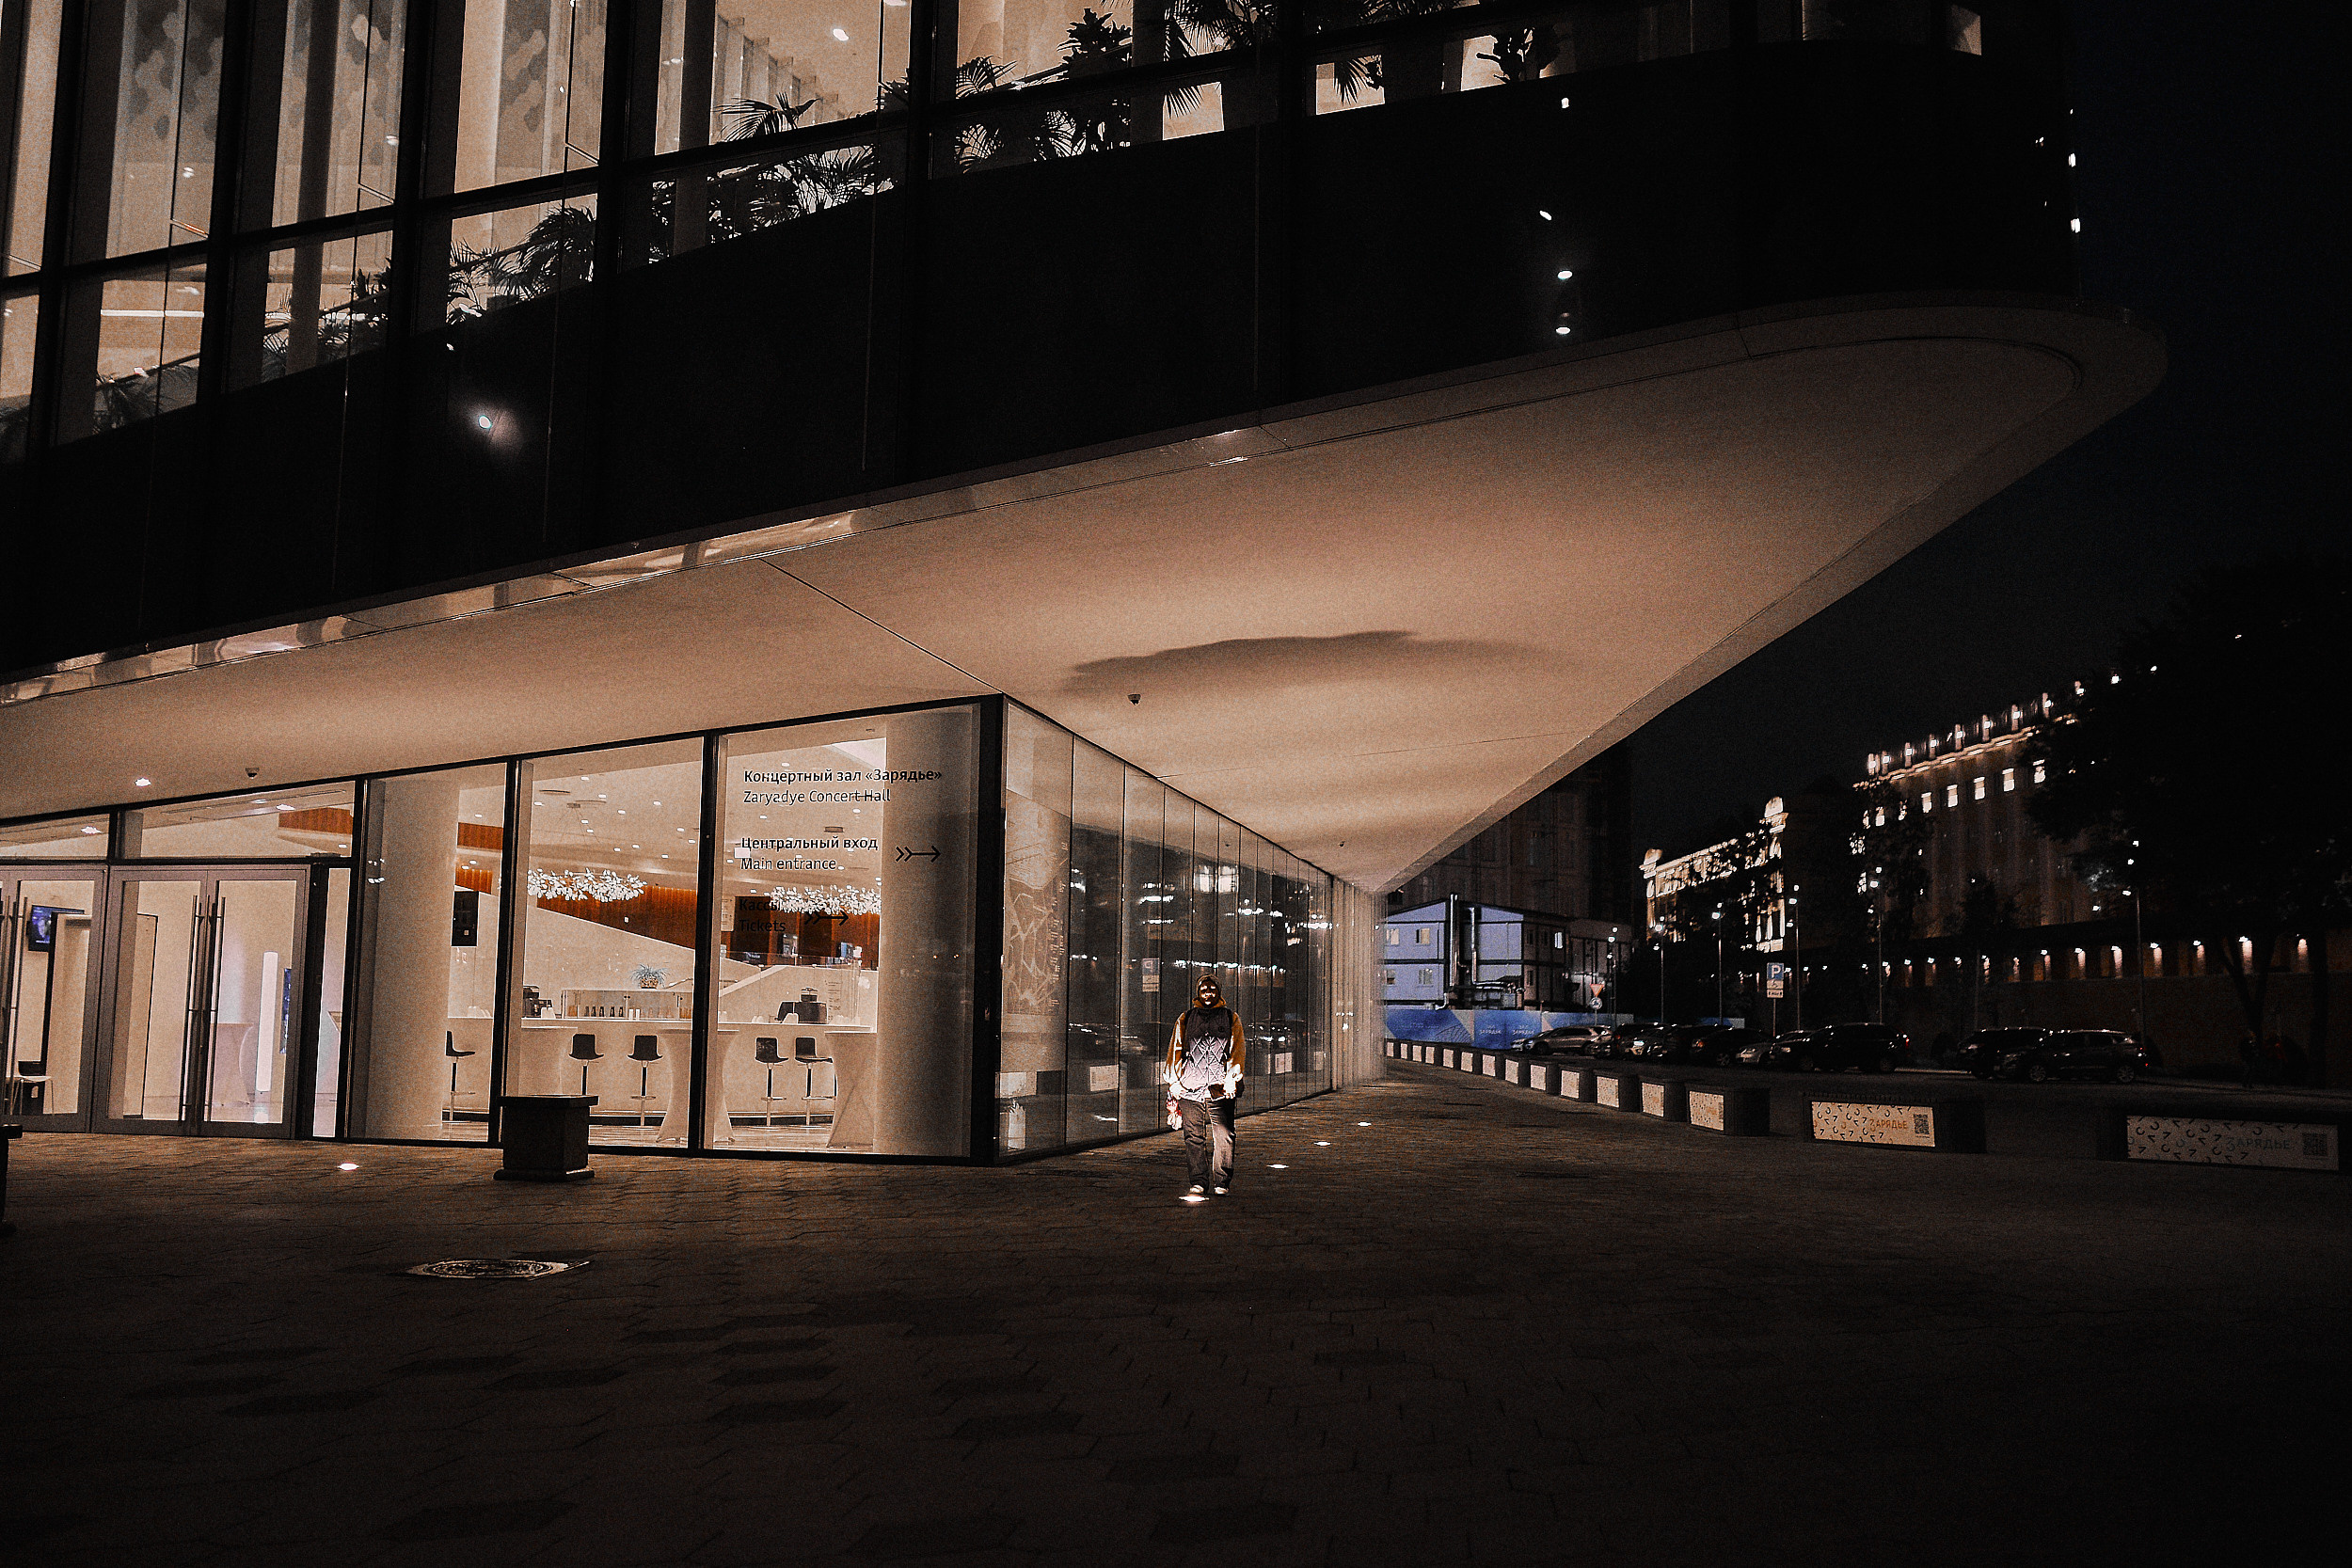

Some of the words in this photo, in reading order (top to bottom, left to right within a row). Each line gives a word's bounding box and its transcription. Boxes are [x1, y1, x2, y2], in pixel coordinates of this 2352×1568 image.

[744, 768, 833, 784] Концертный
[836, 771, 862, 782] зал
[865, 768, 943, 784] «Зарядье»
[743, 789, 805, 806] Zaryadye
[809, 790, 861, 802] Concert
[864, 789, 891, 801] Hall
[741, 836, 839, 852] Центральный
[843, 839, 879, 850] вход
[740, 858, 772, 870] Main
[776, 858, 836, 870] entrance
[739, 898, 781, 911] Кассы
[739, 919, 787, 932] Tickets
[1771, 964, 1782, 979] P
[1869, 1118, 1909, 1132] ЗАРЯДЬЕ
